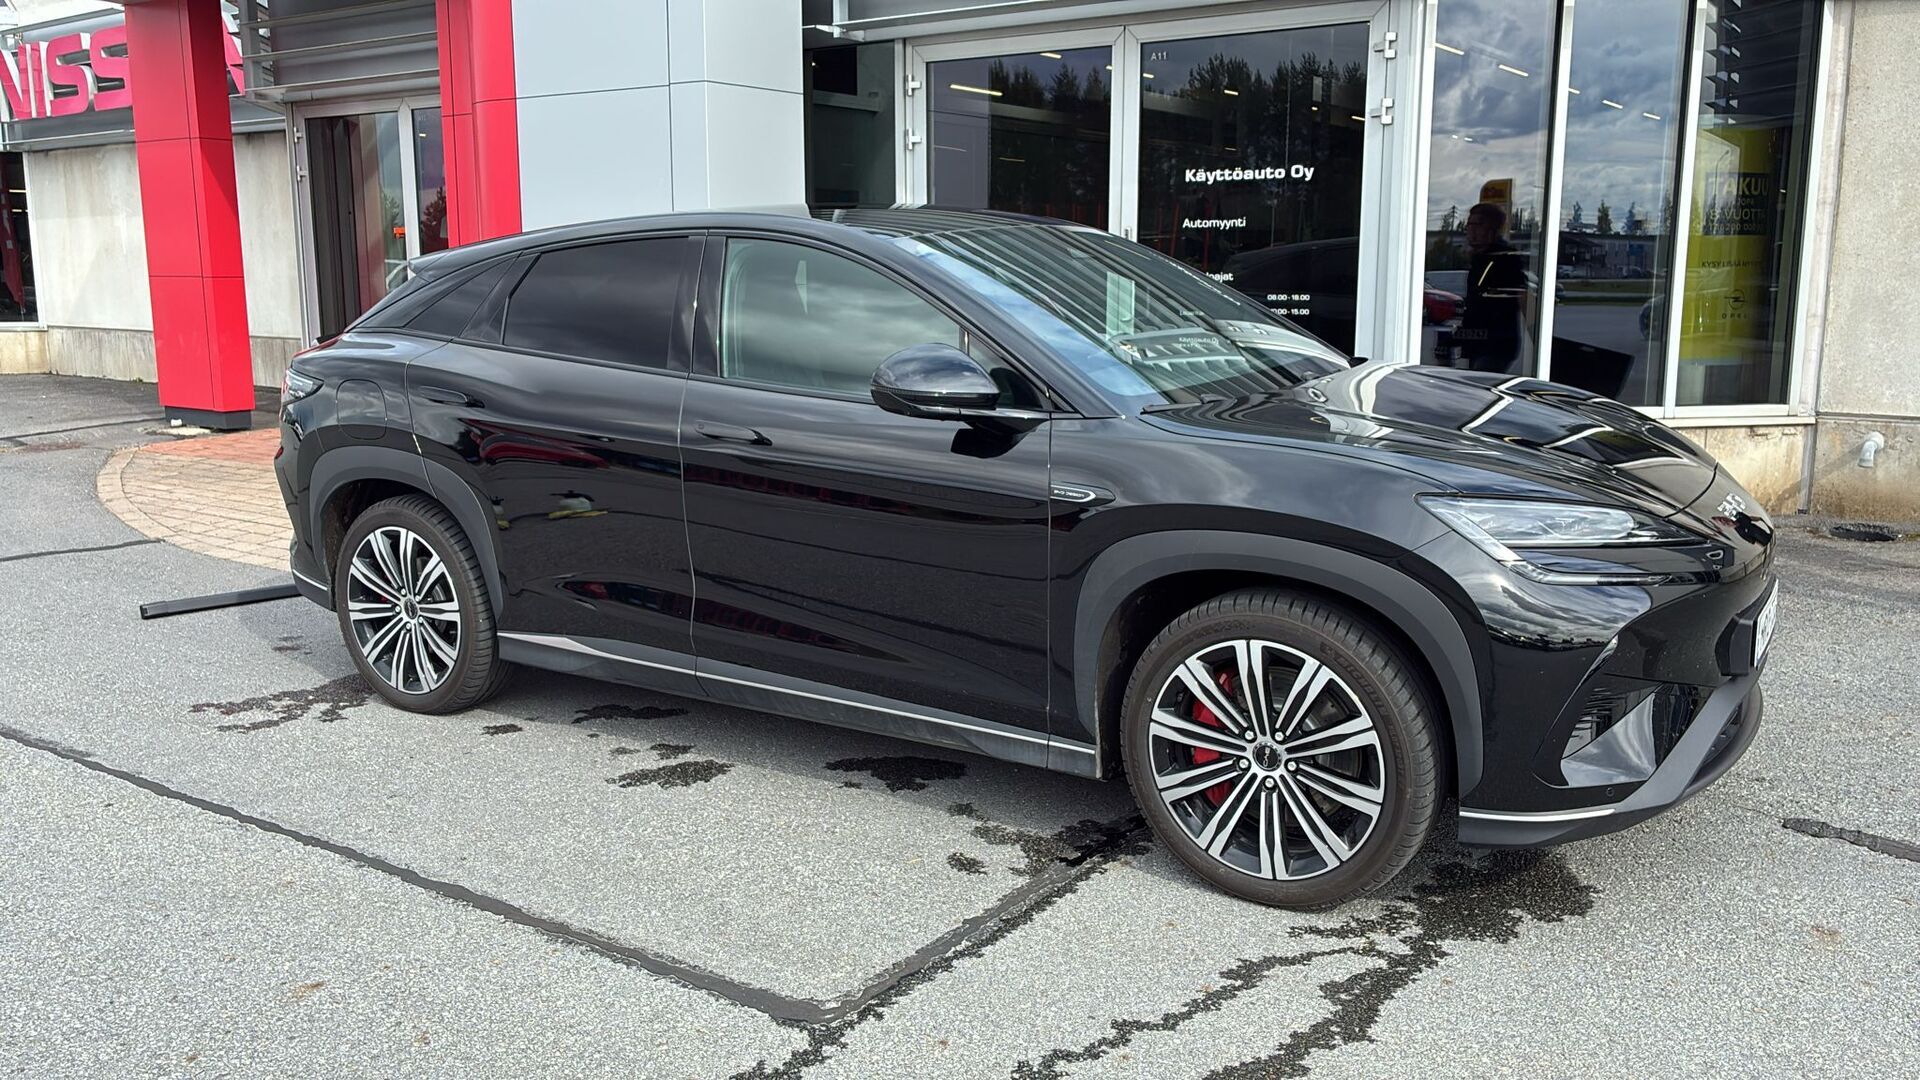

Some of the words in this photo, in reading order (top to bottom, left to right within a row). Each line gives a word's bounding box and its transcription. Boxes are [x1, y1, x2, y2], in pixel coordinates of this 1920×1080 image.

[1185, 167, 1286, 185] Käyttöauto
[1290, 164, 1315, 181] Oy
[1182, 217, 1246, 230] Automyynti
